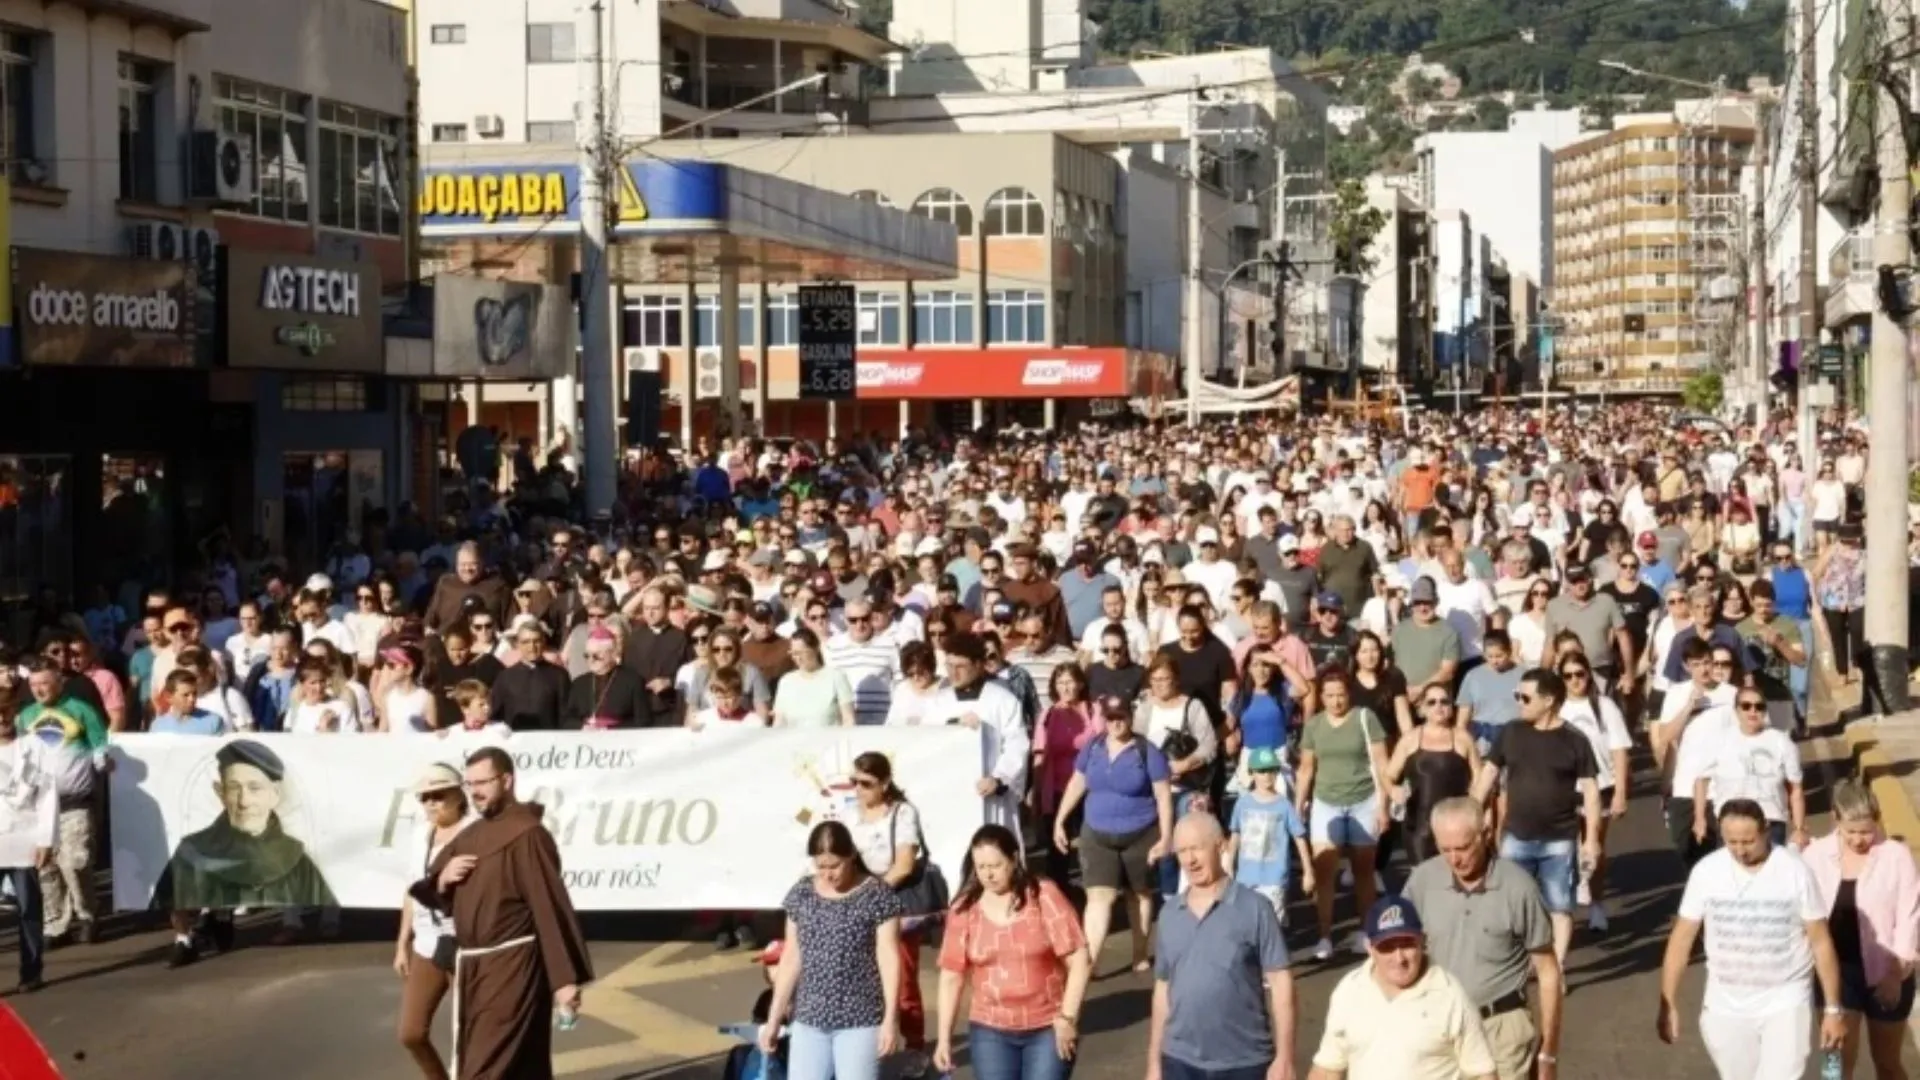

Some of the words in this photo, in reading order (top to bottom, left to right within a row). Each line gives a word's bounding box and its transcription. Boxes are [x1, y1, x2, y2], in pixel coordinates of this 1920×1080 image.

[420, 172, 566, 222] JOAÇABA
[29, 281, 86, 326] doce
[93, 290, 179, 331] amarello
[801, 290, 852, 306] ETANOL
[537, 745, 570, 770] de
[574, 743, 636, 770] Deus
[561, 868, 606, 889] por
[608, 861, 662, 889] nós!
